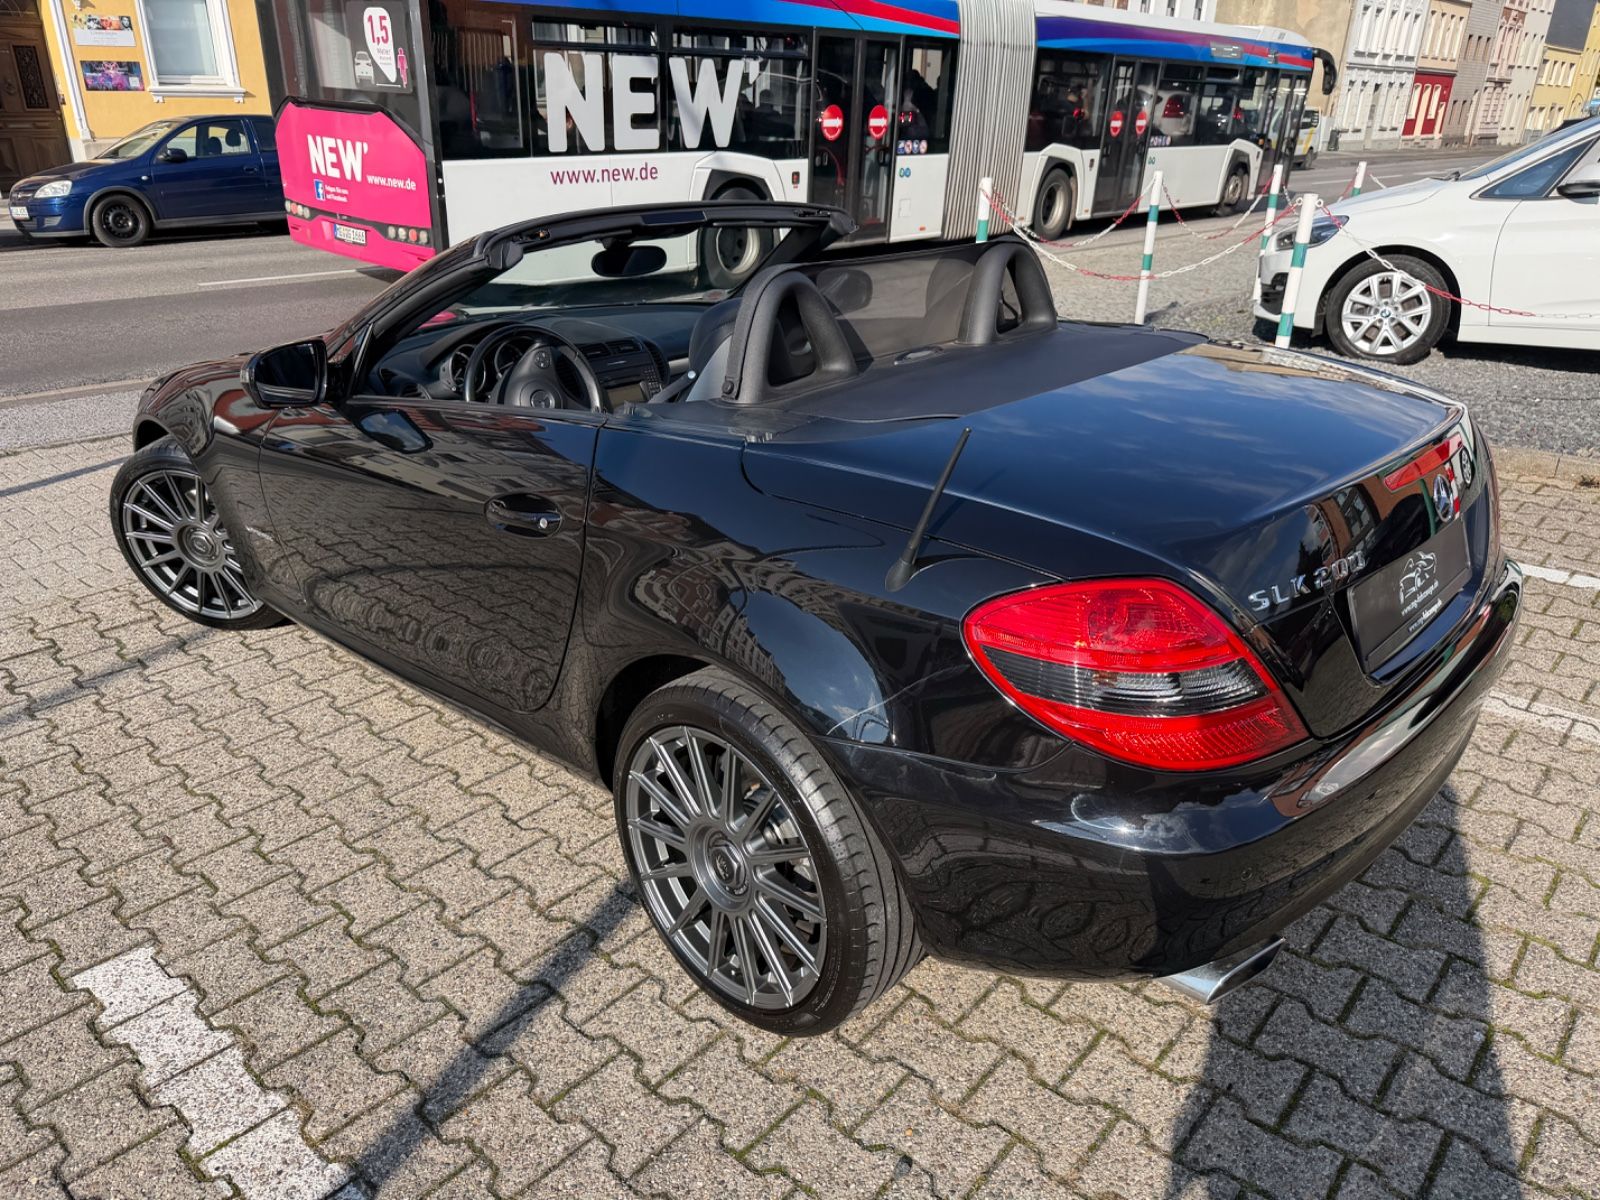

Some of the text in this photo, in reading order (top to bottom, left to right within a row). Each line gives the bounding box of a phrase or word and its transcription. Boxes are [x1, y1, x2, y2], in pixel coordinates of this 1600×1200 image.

[367, 14, 389, 45] 1,5
[366, 174, 417, 190] www.new.de
[550, 162, 658, 185] www.new.de
[1247, 550, 1366, 612] SLK 200
